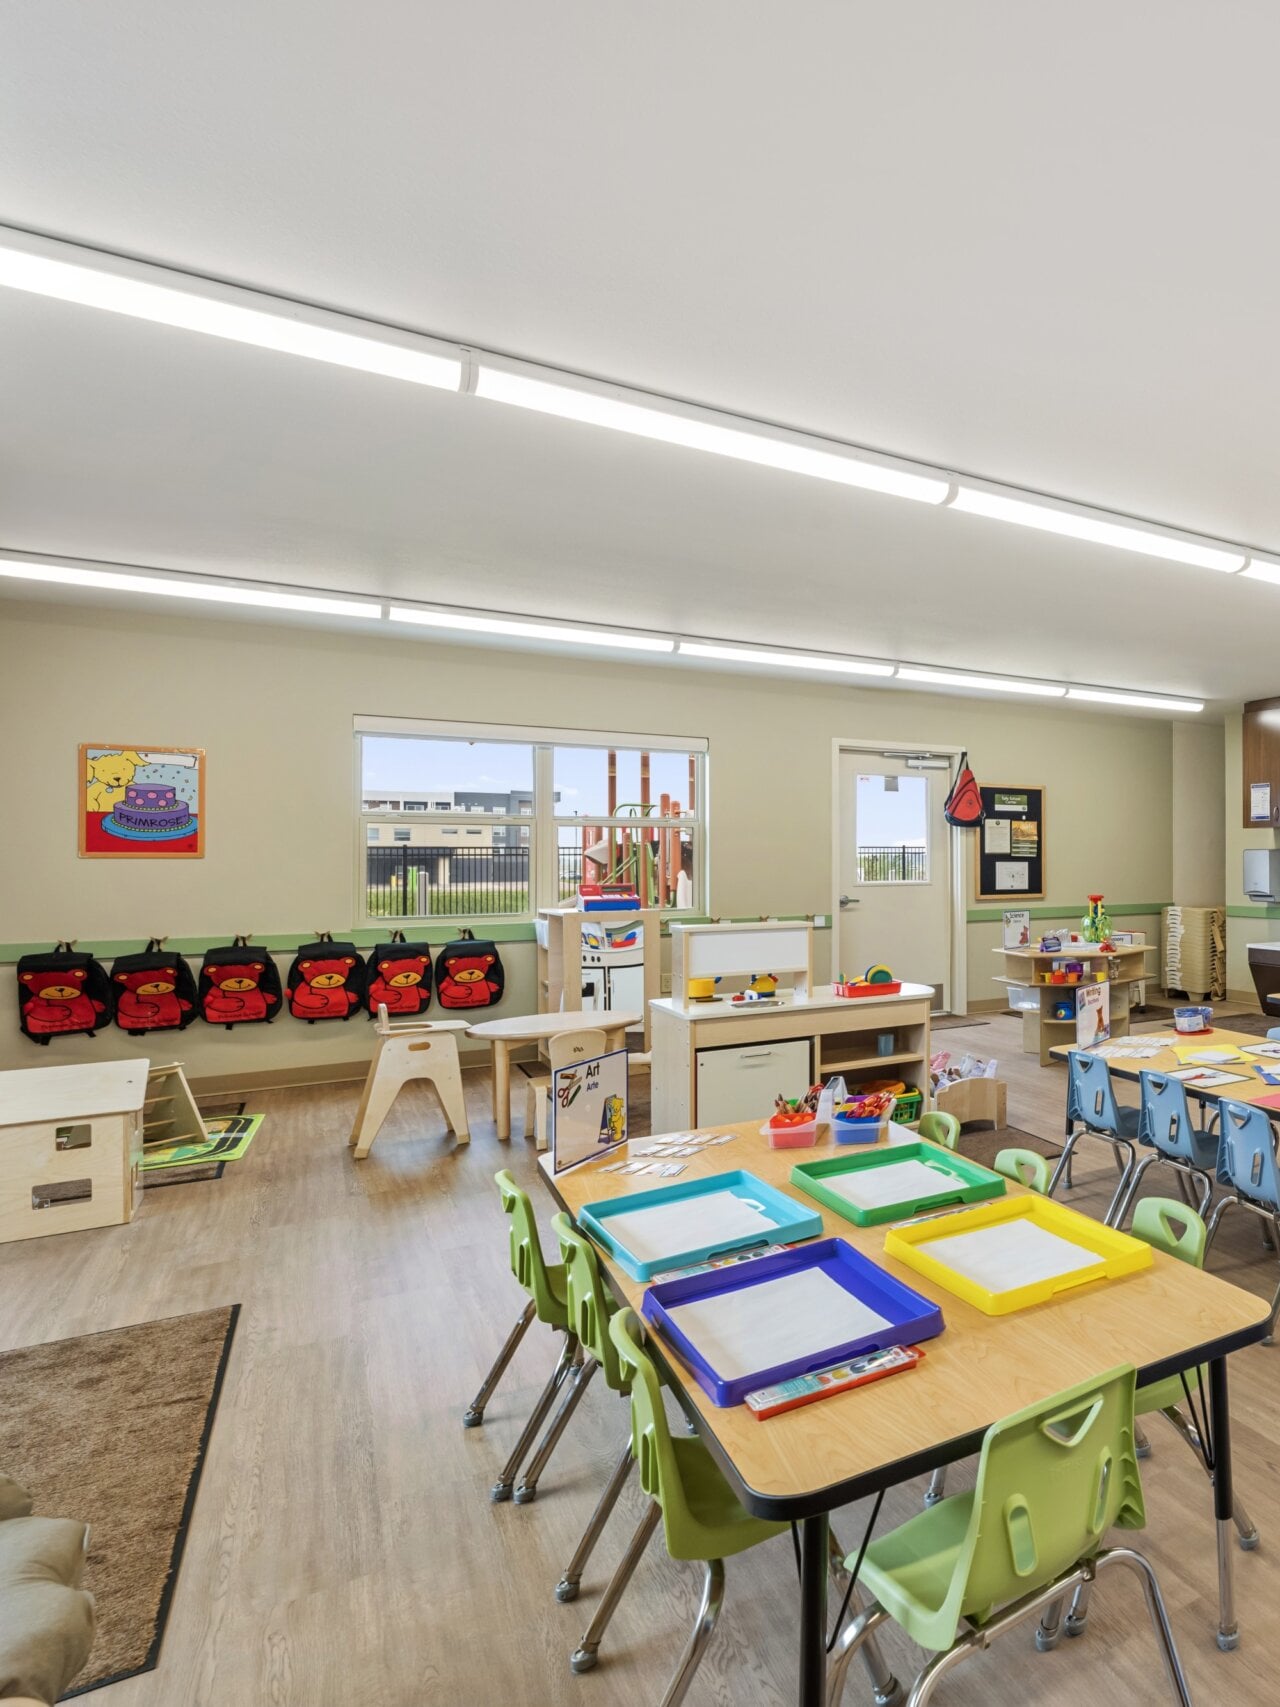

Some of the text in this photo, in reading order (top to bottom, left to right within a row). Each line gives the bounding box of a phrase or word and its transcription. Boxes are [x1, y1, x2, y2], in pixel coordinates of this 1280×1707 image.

[119, 812, 187, 828] PRIMROSE
[585, 1062, 600, 1079] Art
[586, 1081, 599, 1092] Arte
